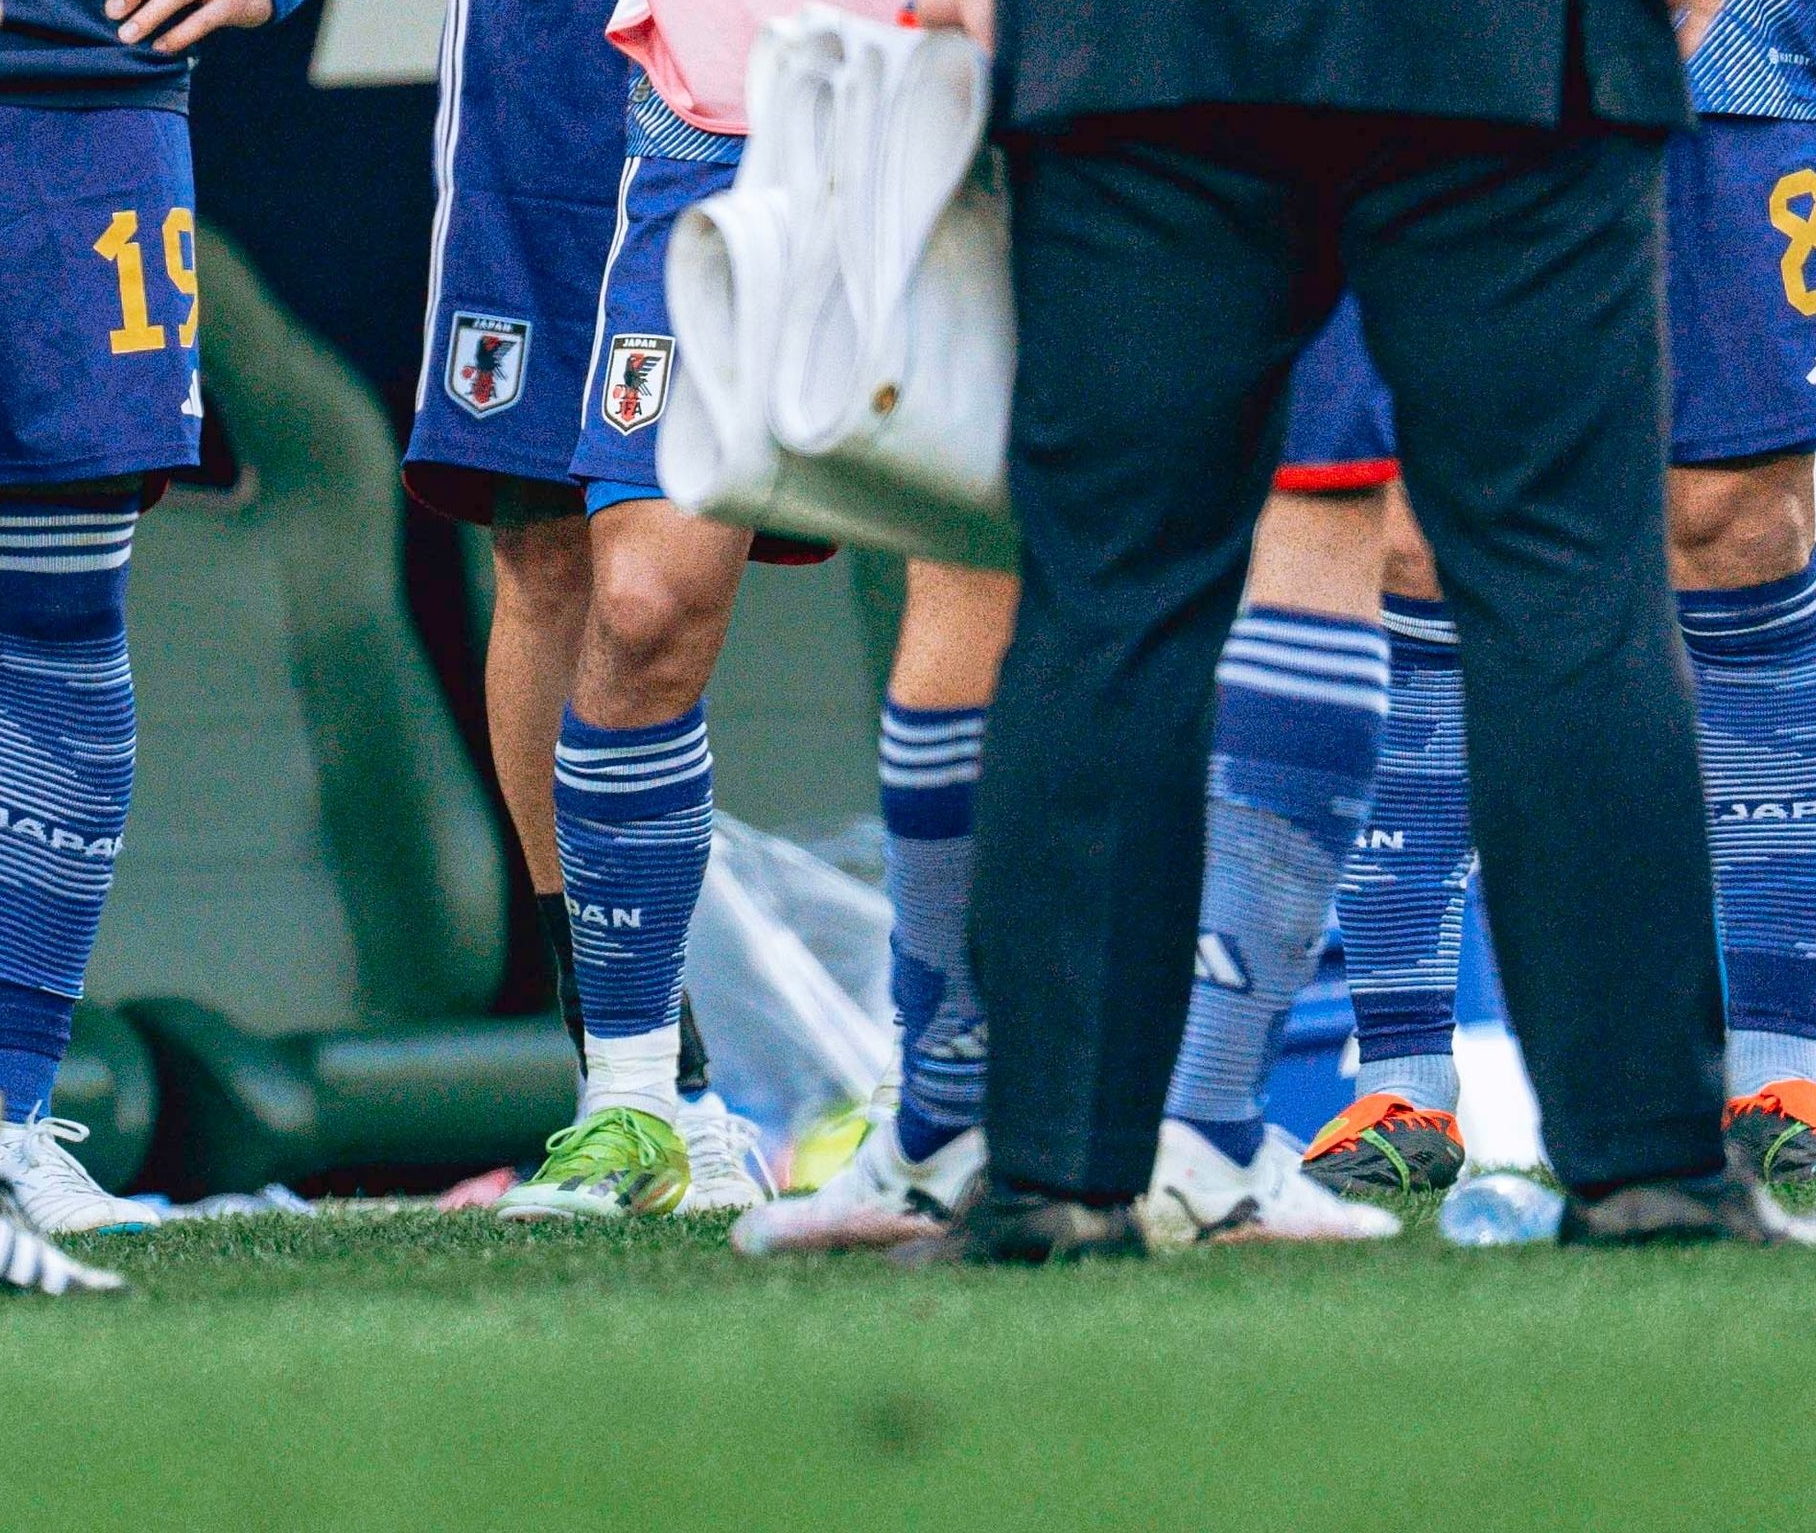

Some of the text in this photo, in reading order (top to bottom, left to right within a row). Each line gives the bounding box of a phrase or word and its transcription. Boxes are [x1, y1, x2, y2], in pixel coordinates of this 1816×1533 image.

[93, 207, 199, 355] 19
[622, 338, 657, 348] JAPAN
[615, 401, 642, 415] JFA
[565, 898, 642, 928] PAN
